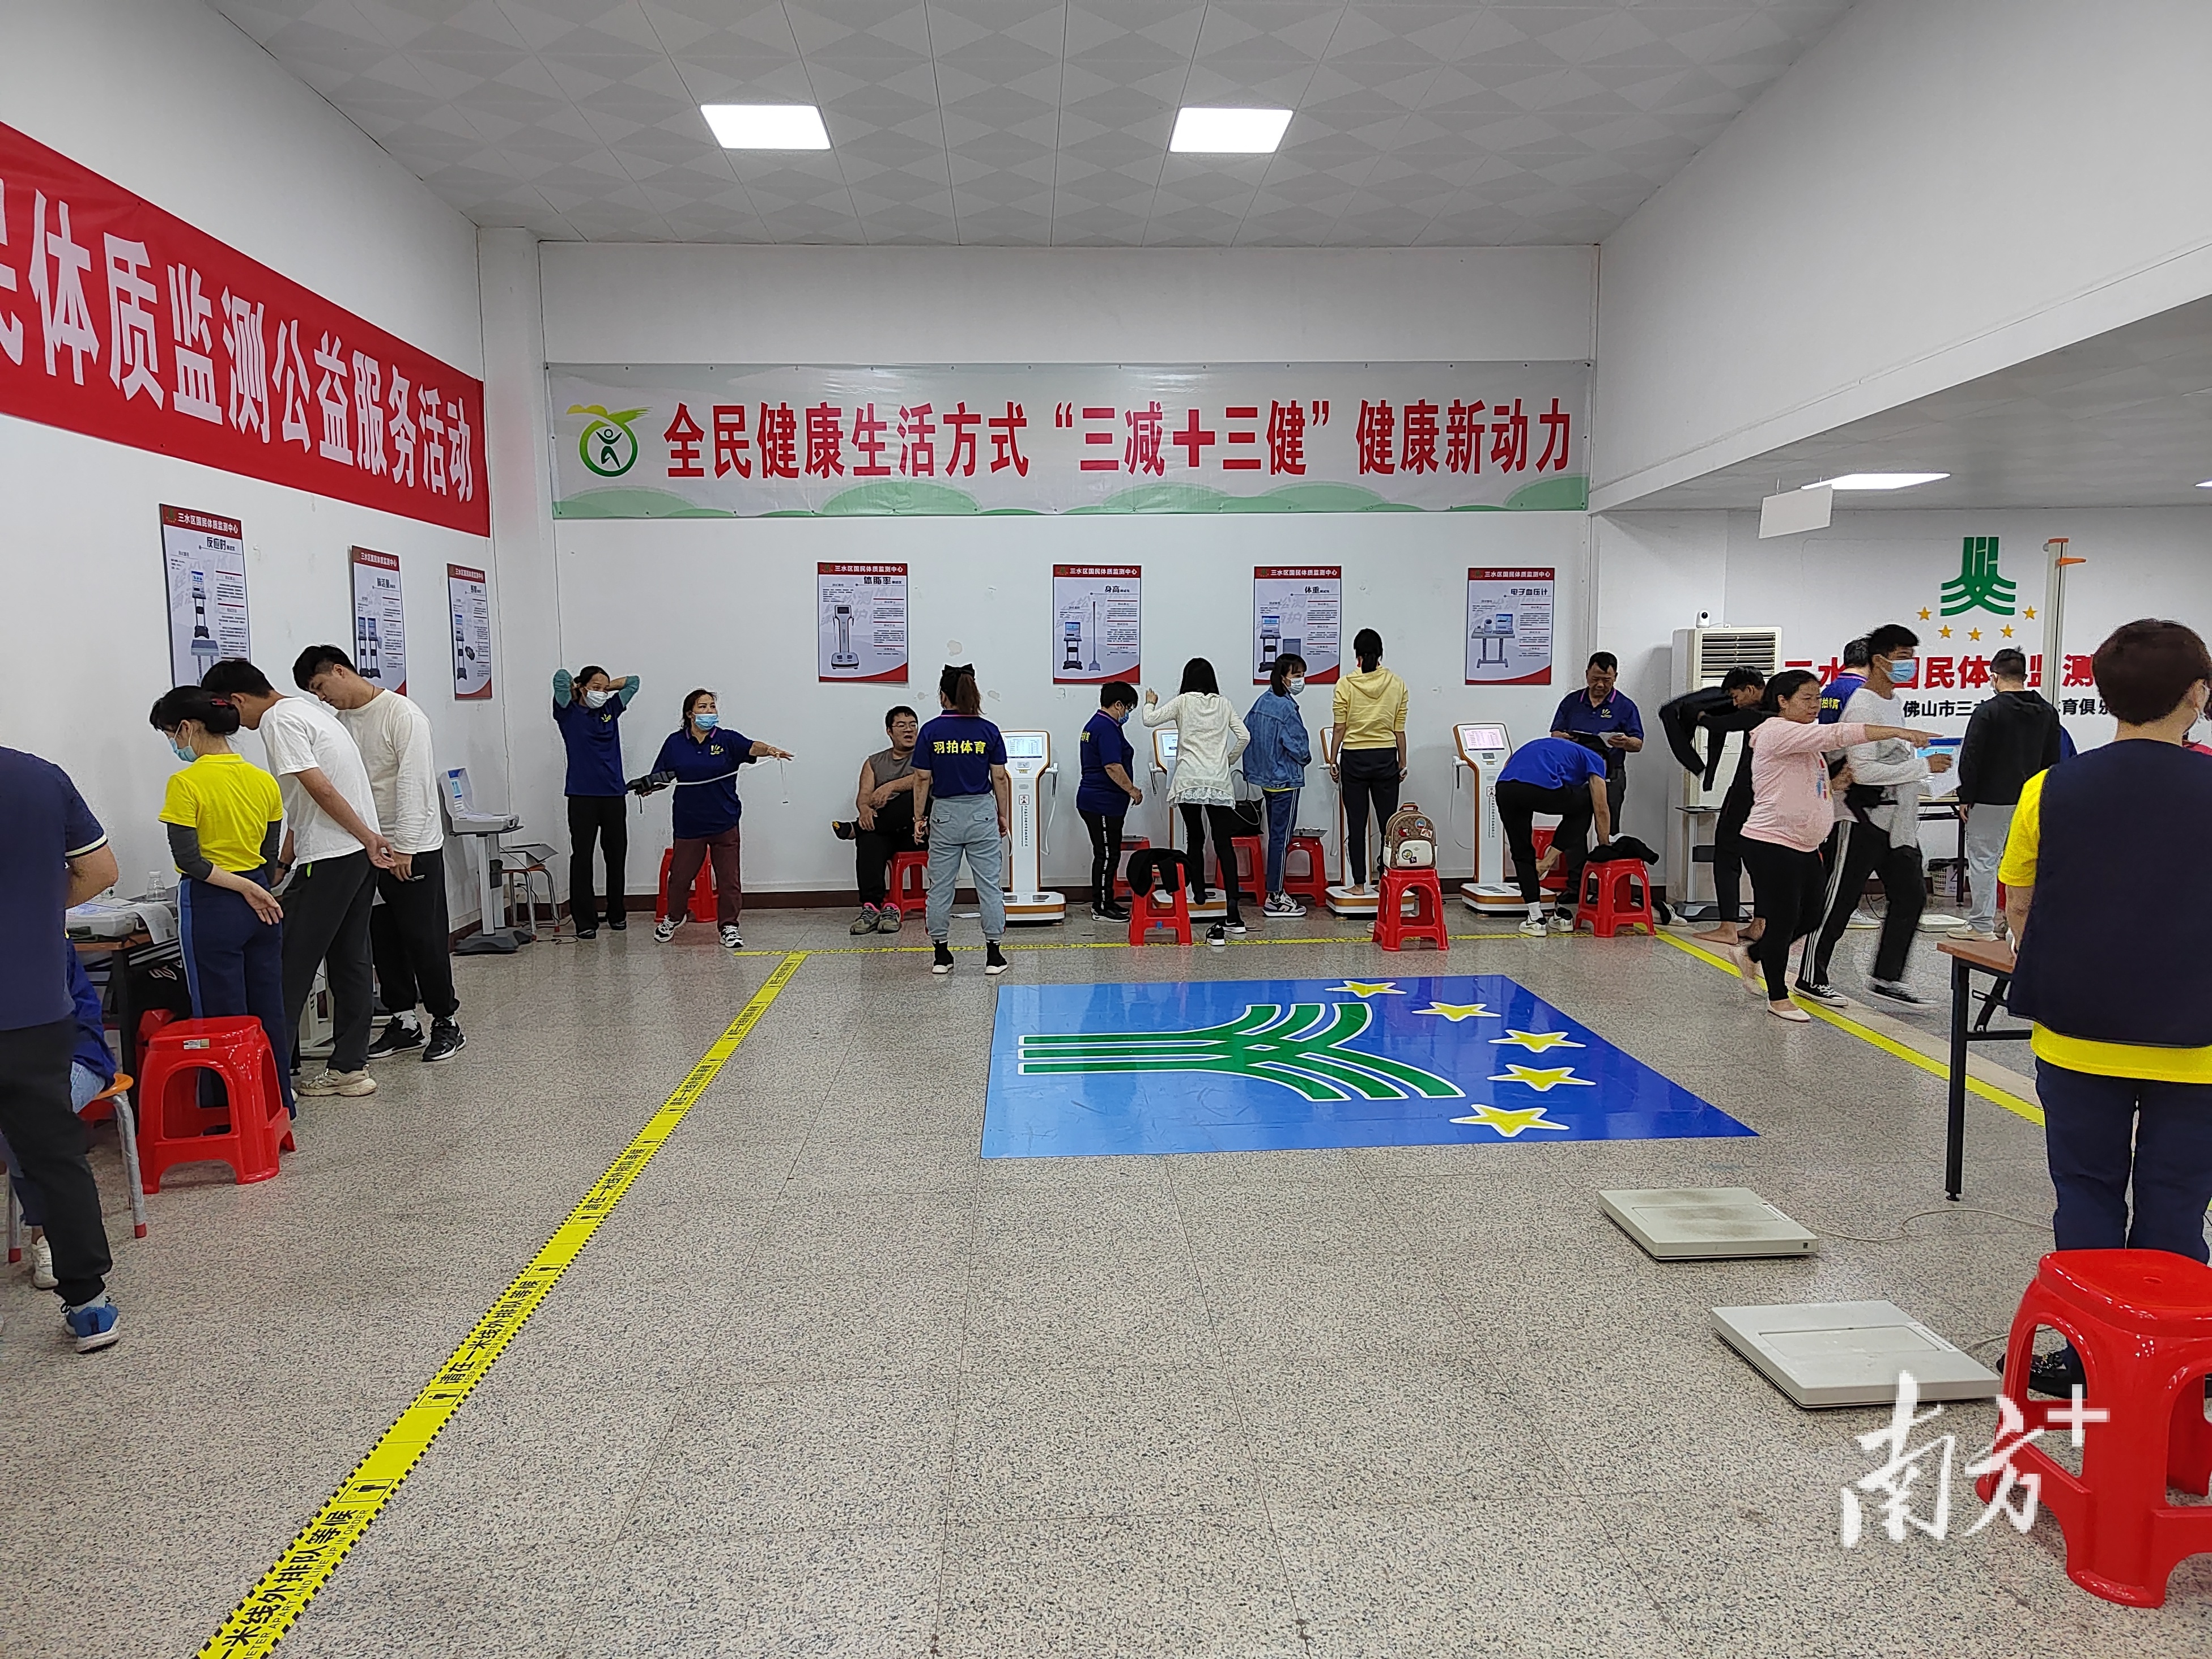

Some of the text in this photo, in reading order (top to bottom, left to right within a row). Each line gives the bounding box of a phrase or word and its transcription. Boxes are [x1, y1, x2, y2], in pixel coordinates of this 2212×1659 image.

[177, 512, 238, 534] 三水区国民体质监测中心
[933, 740, 986, 754] 羽拍体育
[436, 1280, 542, 1384] 请在一米线外排队等候
[462, 1370, 477, 1384] KEEP
[473, 1359, 487, 1369] ONE
[482, 1342, 501, 1358] METER
[496, 1327, 512, 1341] APART
[243, 1632, 273, 1659] ETER
[269, 1600, 297, 1628] APART
[294, 1580, 313, 1597] AND
[308, 1559, 330, 1577] LINE
[324, 1547, 338, 1557] UP
[343, 1509, 370, 1535] ORDER
